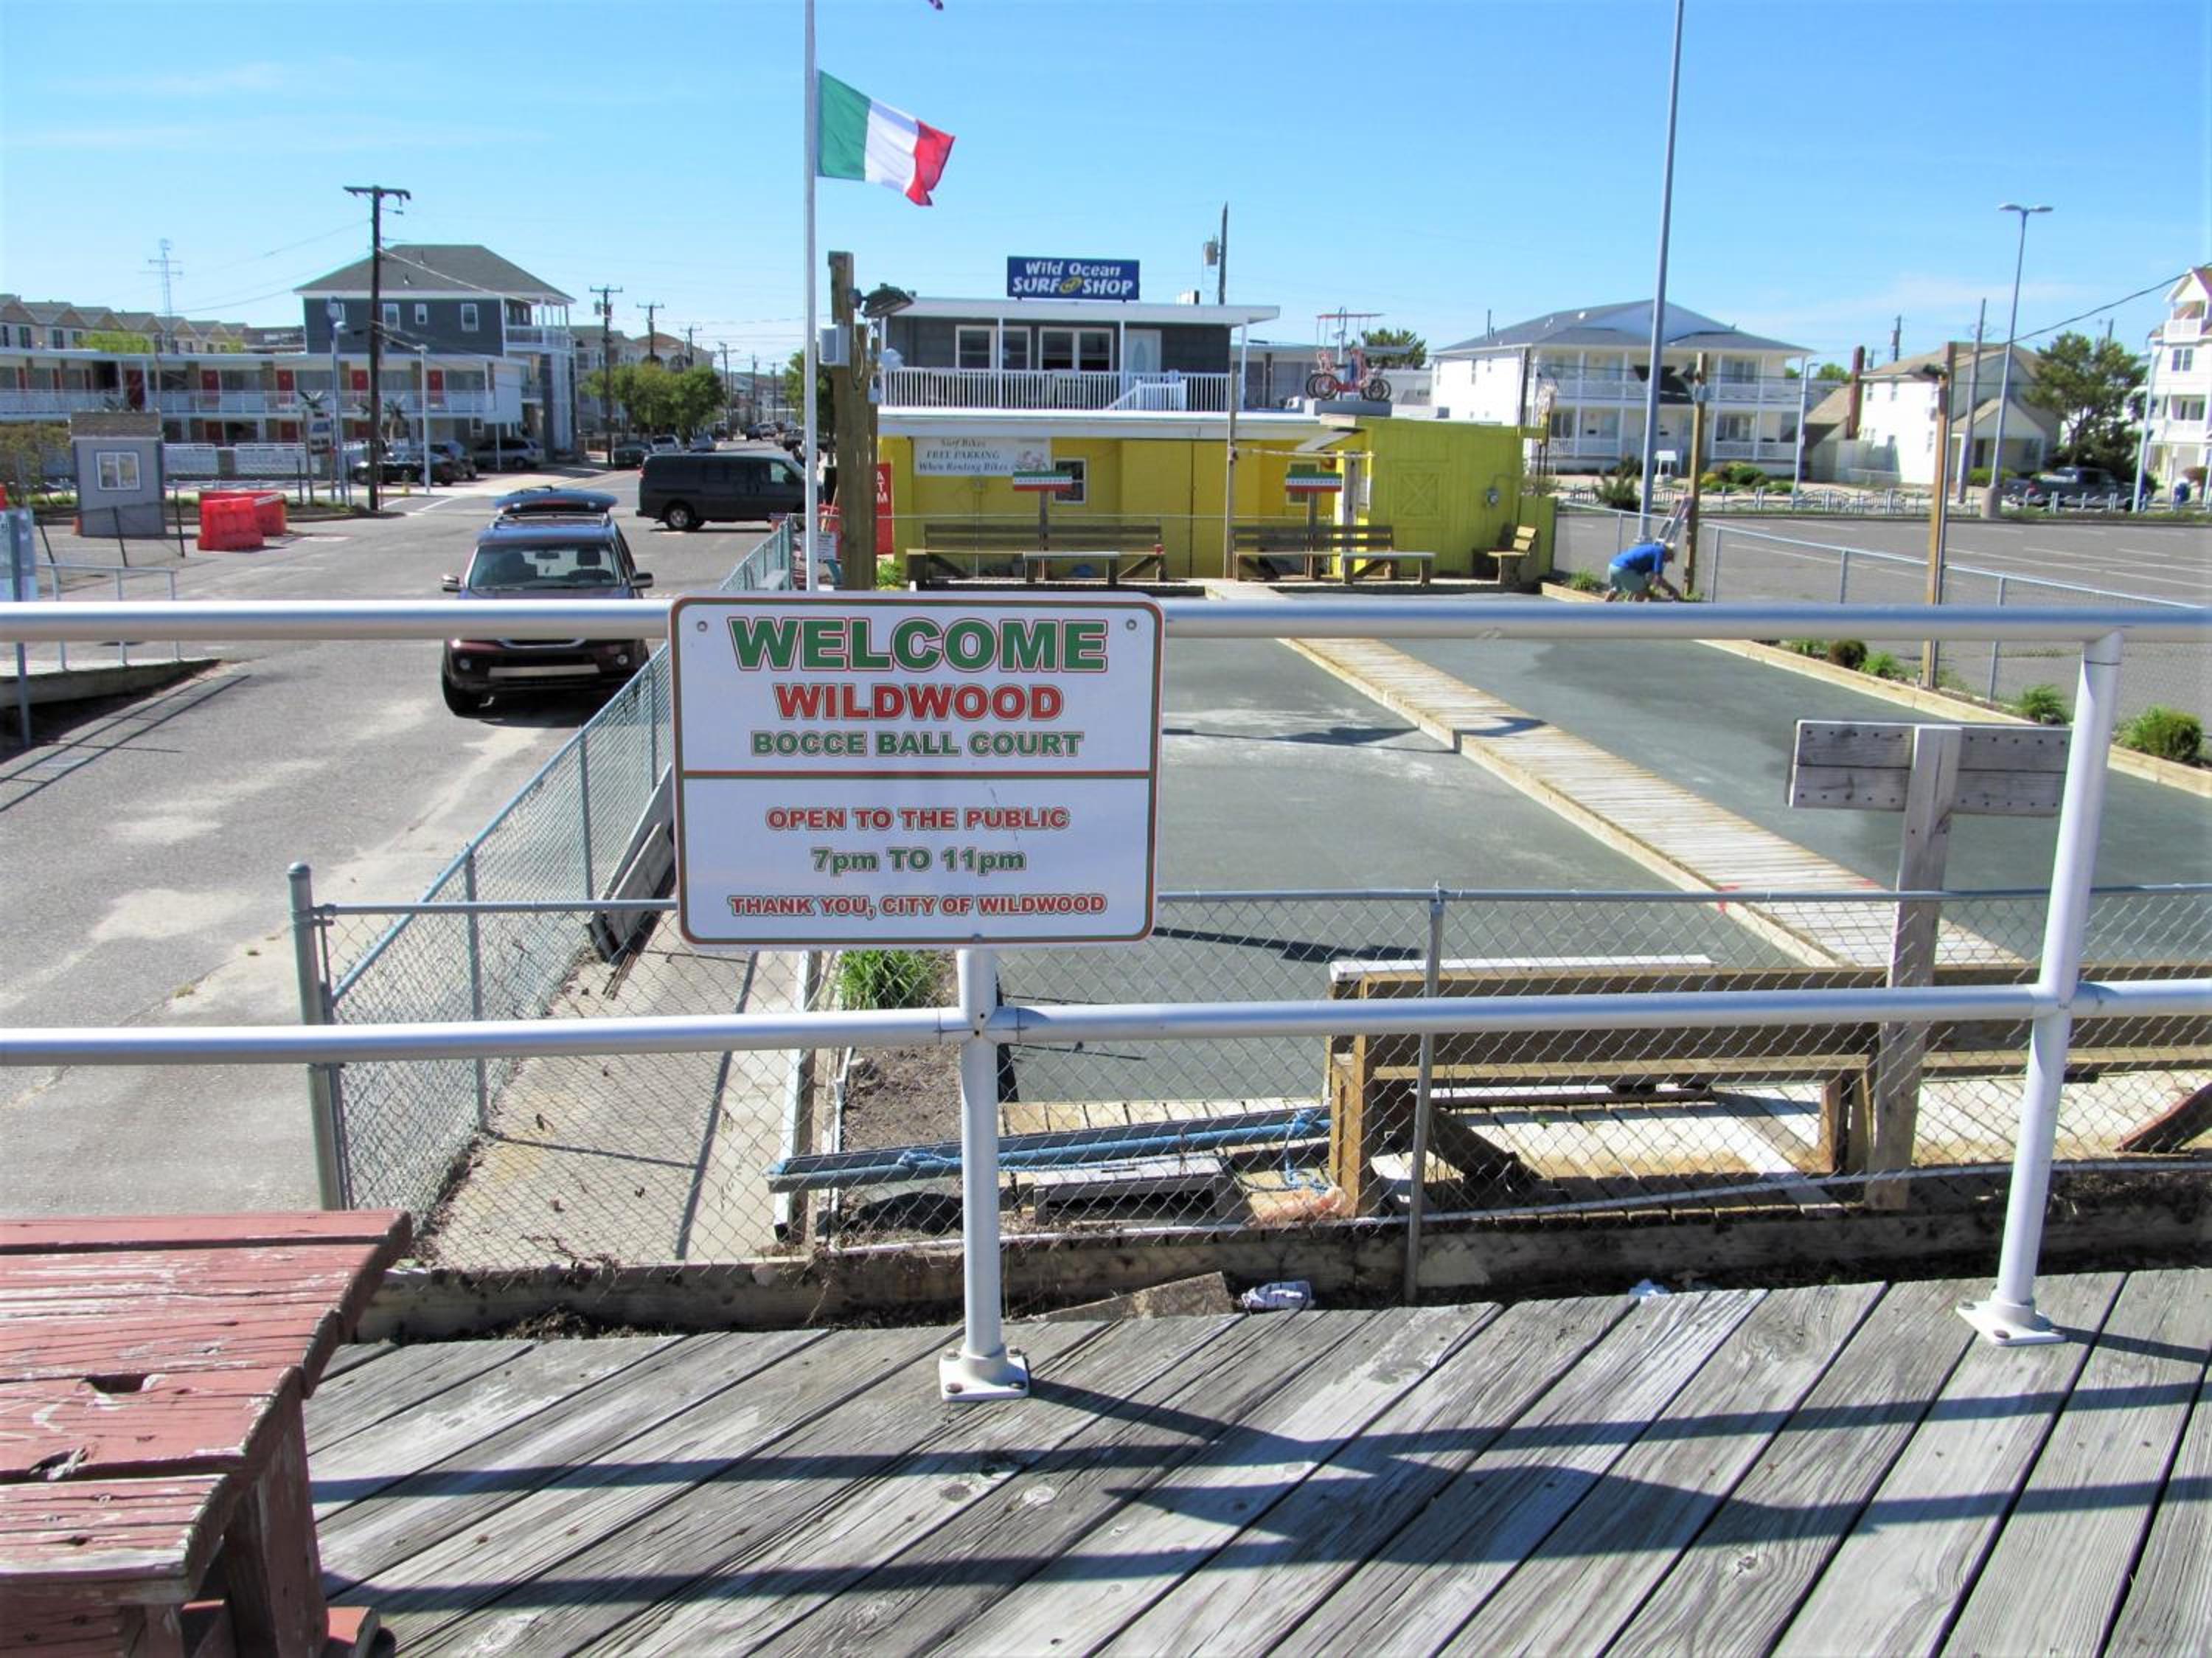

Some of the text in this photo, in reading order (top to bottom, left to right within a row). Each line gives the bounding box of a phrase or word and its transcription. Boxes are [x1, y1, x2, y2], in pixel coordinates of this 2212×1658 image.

[1026, 261, 1121, 277] Wild Ocean
[1012, 277, 1062, 293] SURF
[1081, 278, 1133, 295] SHOP
[919, 460, 944, 471] When
[926, 449, 1000, 459] FREE PARKING
[728, 617, 1107, 673] WELCOME
[773, 683, 1064, 721] WILDWOOD
[751, 730, 1084, 757] BOCCE BALL COURT
[766, 807, 1071, 830] OPEN TO THE PUBLIC
[811, 847, 1026, 876] 7pm TO 11pm
[728, 894, 1107, 920] THANK YOU, CITY OF WILDWOOD
